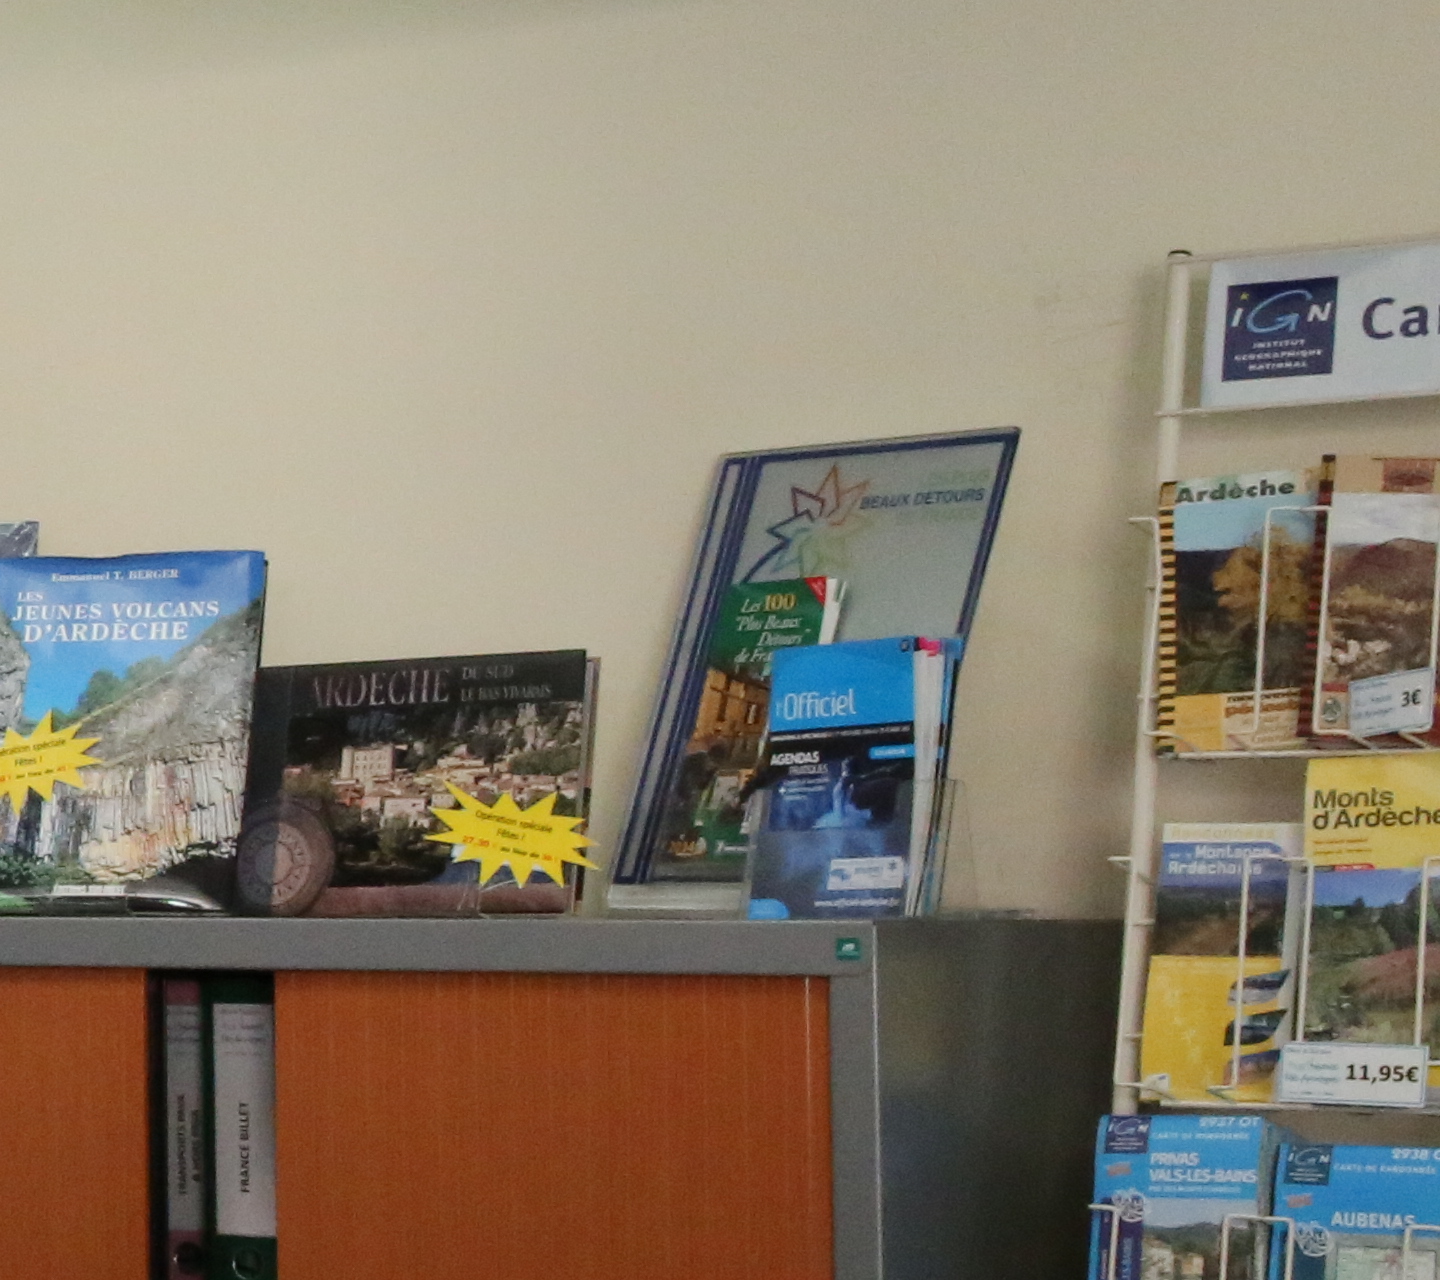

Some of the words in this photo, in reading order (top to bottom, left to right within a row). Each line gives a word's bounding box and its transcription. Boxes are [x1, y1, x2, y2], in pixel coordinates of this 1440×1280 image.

[1230, 288, 1334, 333] IGN
[1362, 296, 1440, 340] Ca
[860, 492, 911, 510] BEAUX
[1174, 479, 1296, 504] Ardèche
[51, 571, 110, 582] Emmanuel
[113, 570, 124, 581] T.
[128, 568, 179, 580] BERGER
[17, 591, 44, 602] LES
[740, 599, 761, 613] Les
[763, 593, 797, 612] 100
[12, 603, 102, 621] JEUNES
[113, 600, 220, 619] VOLCANS
[23, 619, 189, 643] D'ARDÈCHE
[764, 616, 803, 630] Beaux
[733, 649, 749, 663] de
[485, 665, 514, 678] SUD
[1401, 688, 1422, 708] 3€
[33, 739, 66, 752] spéciale
[770, 751, 820, 766] AGENDAS
[1312, 787, 1394, 809] Monts
[1345, 1063, 1419, 1086] 11,95€
[238, 1102, 250, 1142] BILLET
[1150, 1152, 1200, 1166] PRIVAS
[238, 1144, 251, 1194] FRANCE
[1149, 1168, 1257, 1184] VALS-LES-BAINS
[1330, 1211, 1417, 1229] AUBENAS
